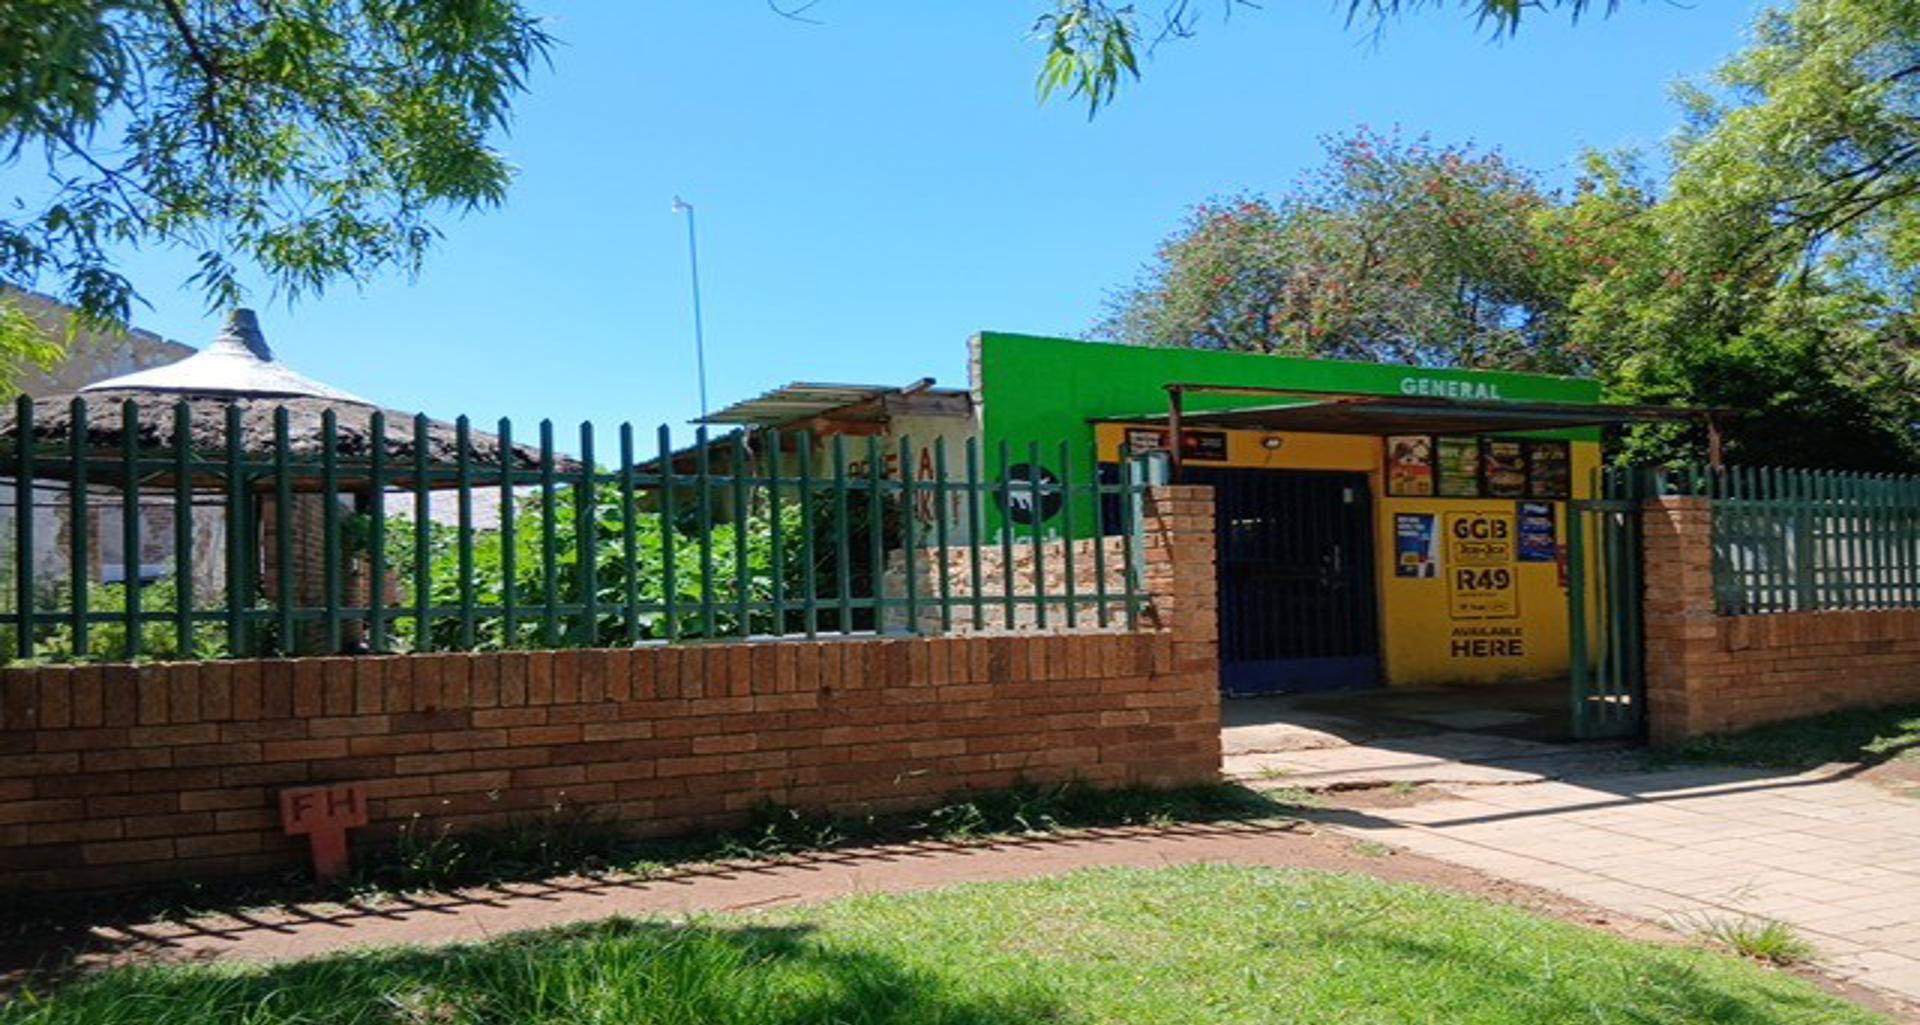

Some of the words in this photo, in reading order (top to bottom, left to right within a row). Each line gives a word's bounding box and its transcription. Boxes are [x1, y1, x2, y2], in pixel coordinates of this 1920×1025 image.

[1400, 377, 1501, 400] GENERAL
[1457, 568, 1510, 590] R49
[1451, 626, 1523, 637] AVAILABLE
[1451, 639, 1524, 658] HERE
